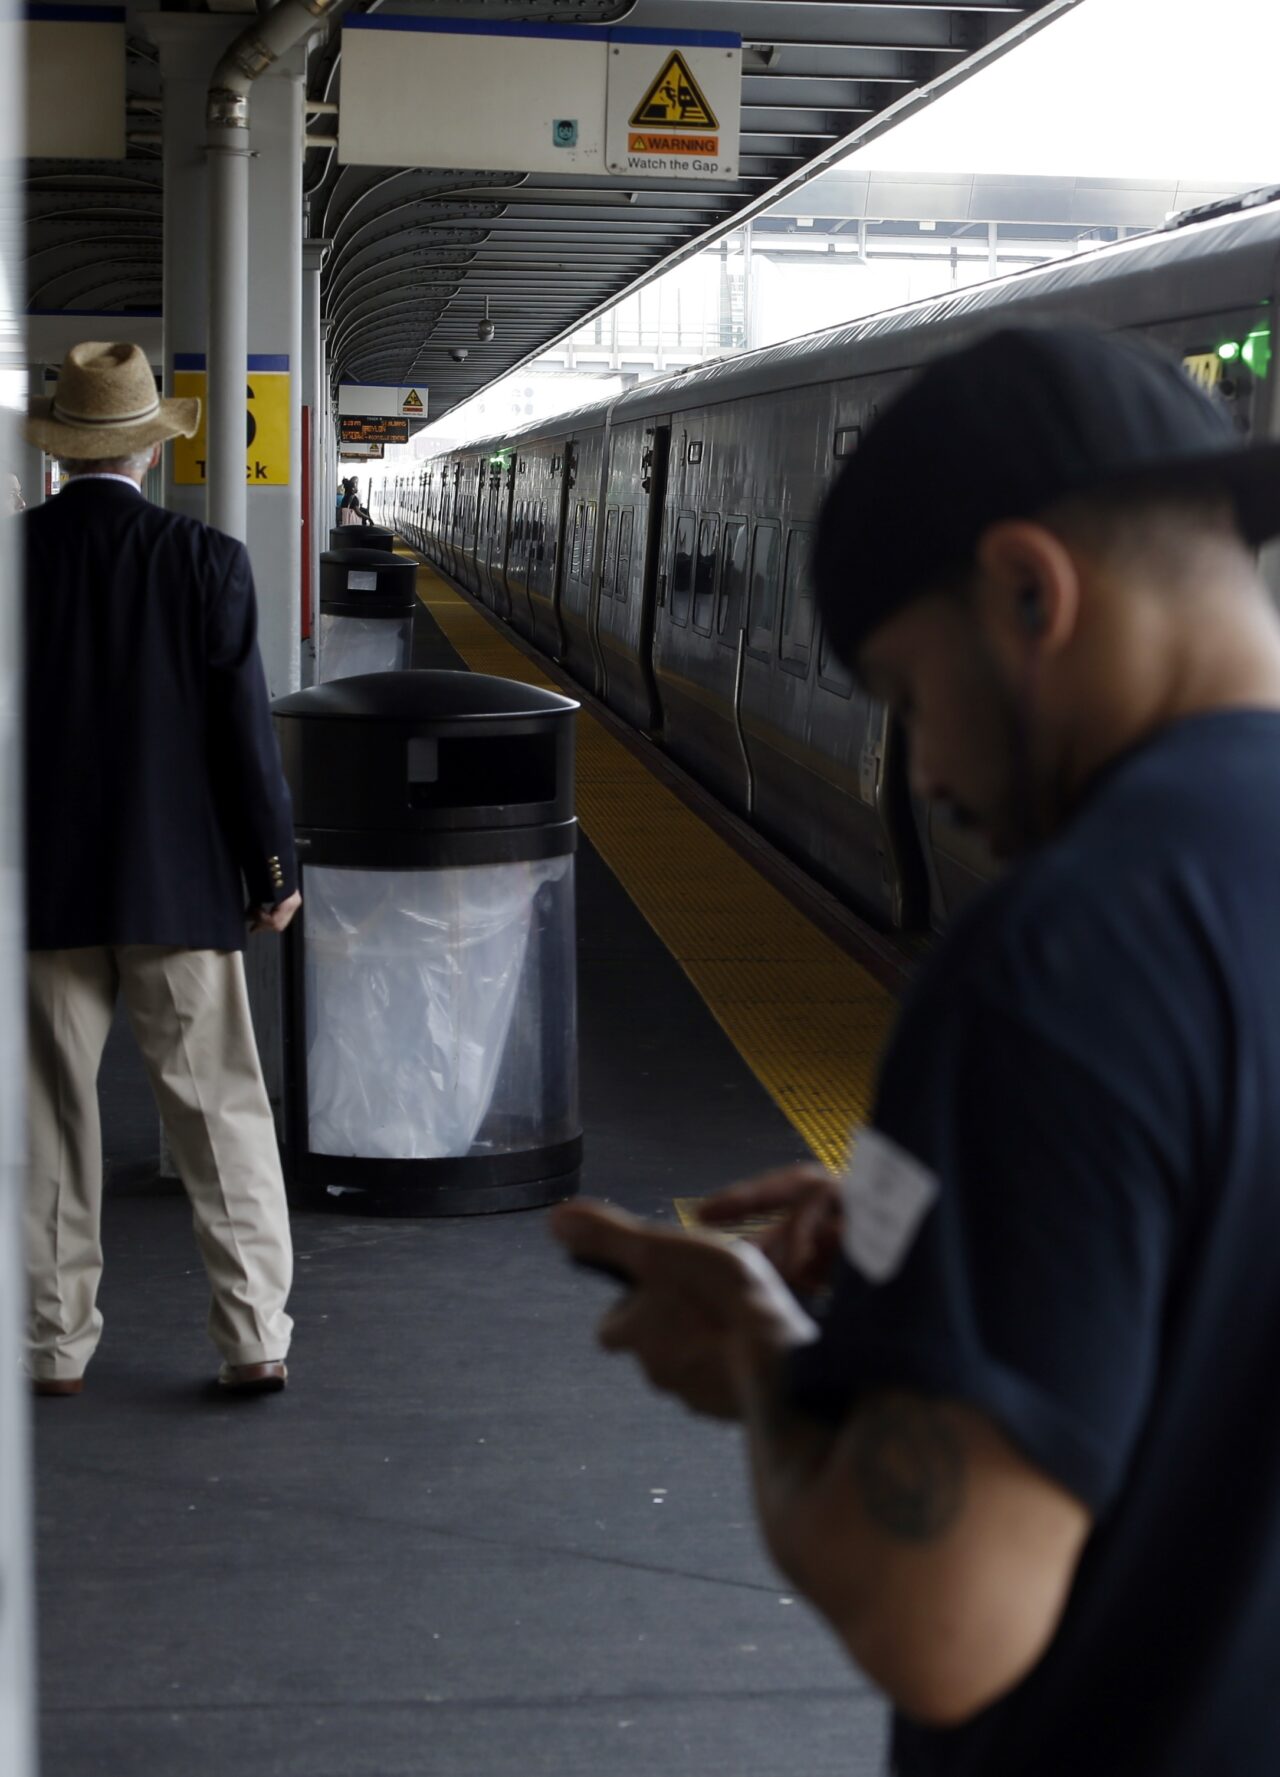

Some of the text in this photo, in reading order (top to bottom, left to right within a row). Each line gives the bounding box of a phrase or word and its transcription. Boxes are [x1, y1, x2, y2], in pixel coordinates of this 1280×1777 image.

[648, 138, 715, 152] WARNING
[628, 157, 718, 174] Watch the Gap
